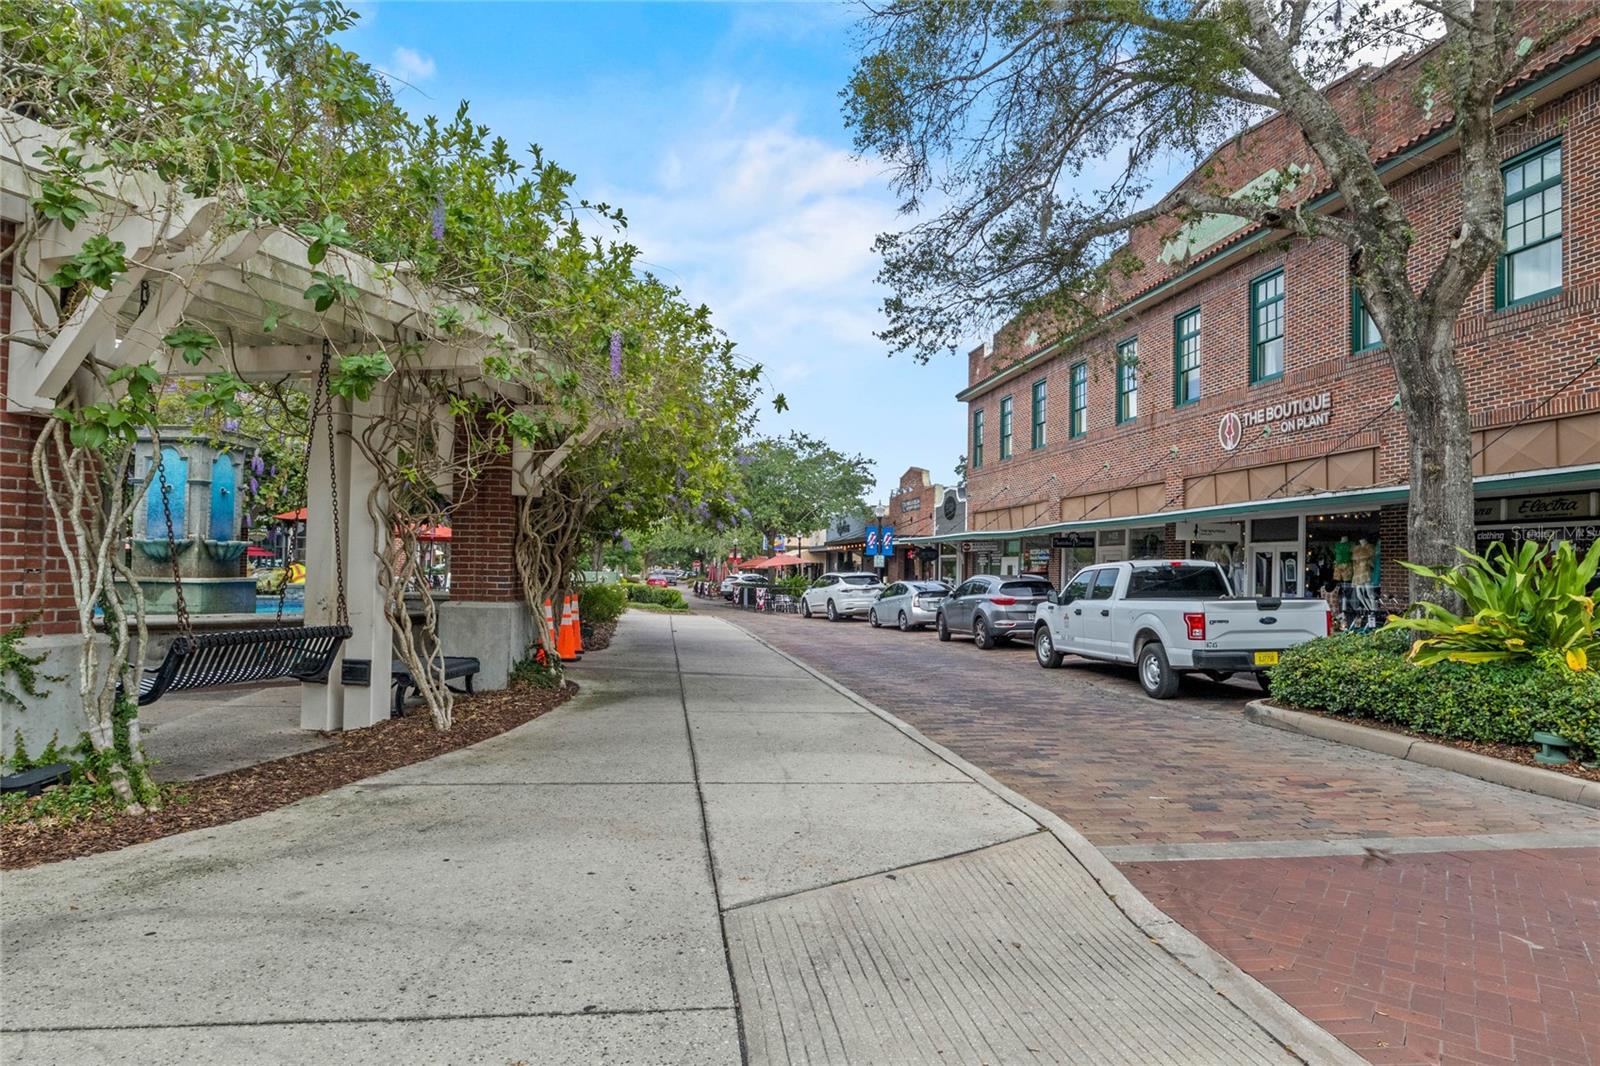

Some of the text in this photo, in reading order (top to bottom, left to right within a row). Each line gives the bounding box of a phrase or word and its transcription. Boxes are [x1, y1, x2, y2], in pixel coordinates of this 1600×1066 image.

[1243, 392, 1331, 426] THE BOUTIQUE
[1280, 412, 1330, 433] ON PLANT
[1518, 497, 1577, 513] Electra
[1477, 532, 1505, 541] clothing
